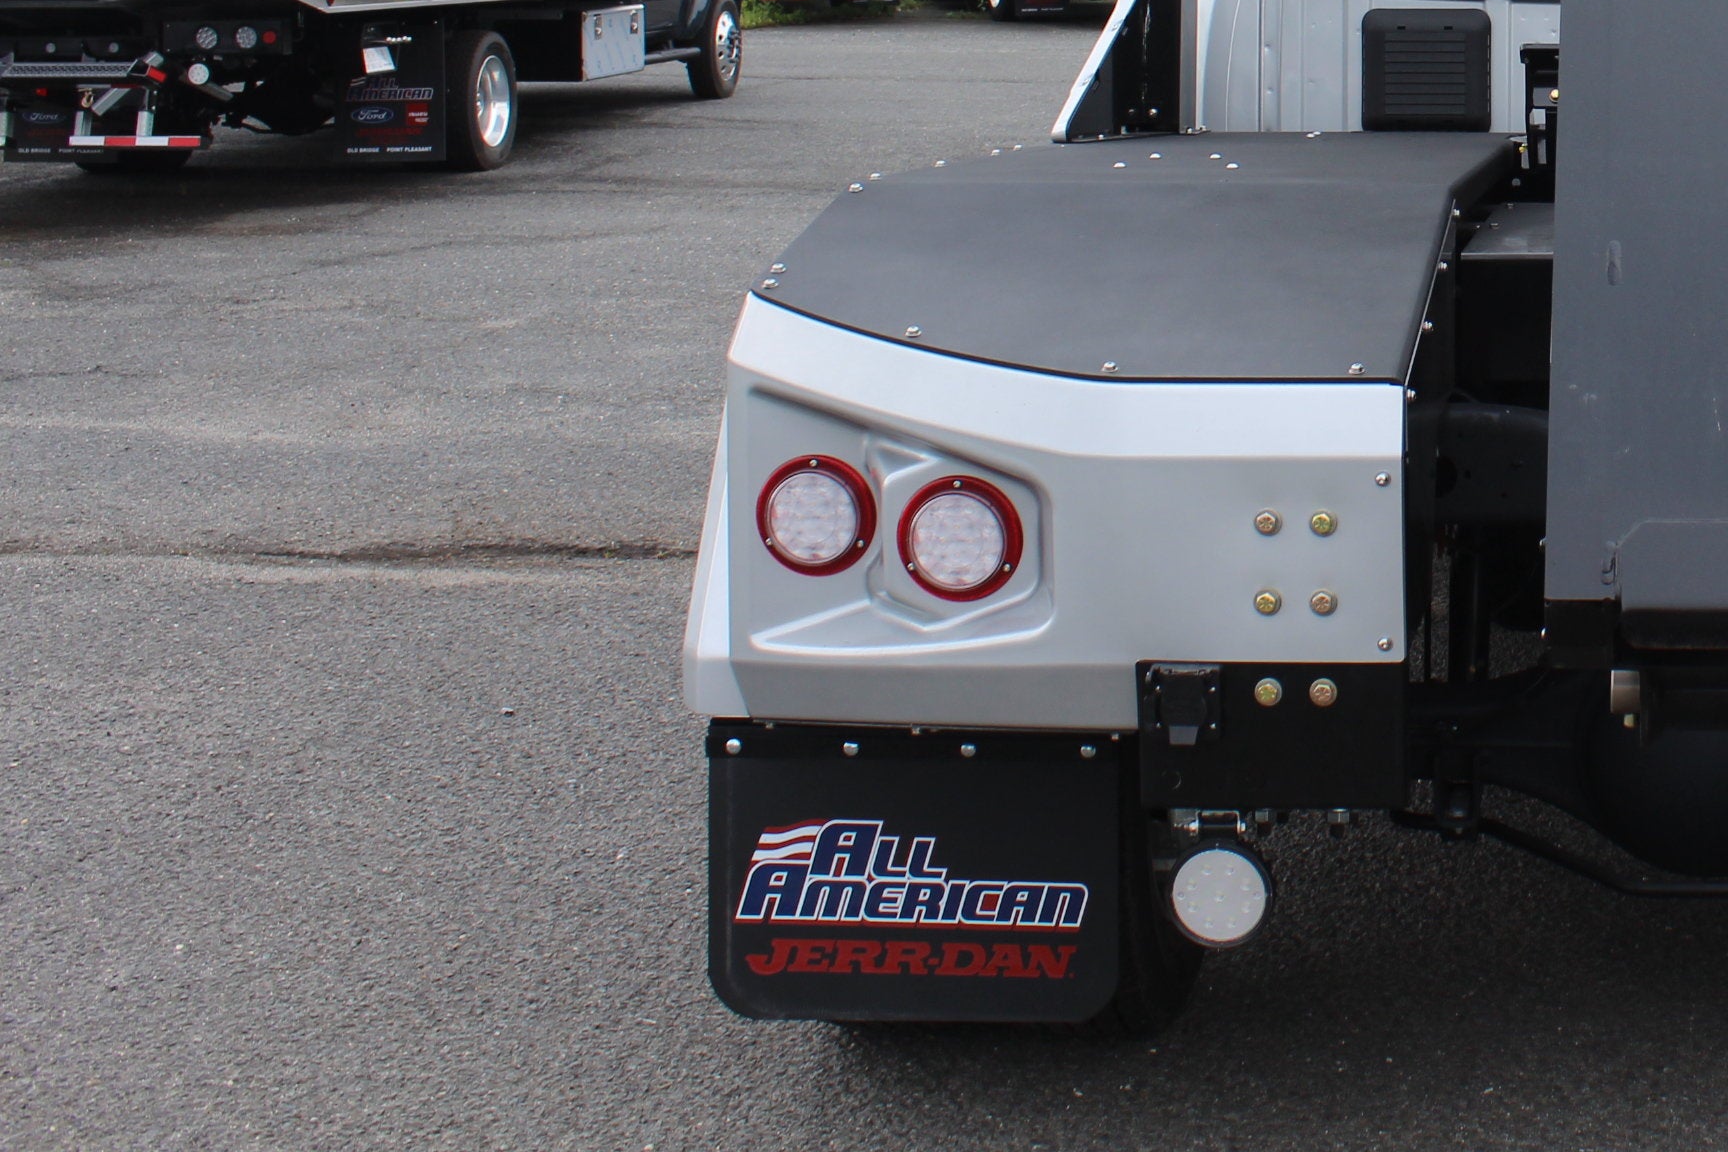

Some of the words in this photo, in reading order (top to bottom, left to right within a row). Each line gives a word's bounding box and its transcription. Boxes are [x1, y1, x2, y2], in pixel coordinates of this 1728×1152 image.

[346, 87, 434, 102] AMERICAN
[809, 819, 947, 879] ALL
[735, 859, 1089, 931] AMERICAN
[745, 938, 1077, 979] JERR-DAN
